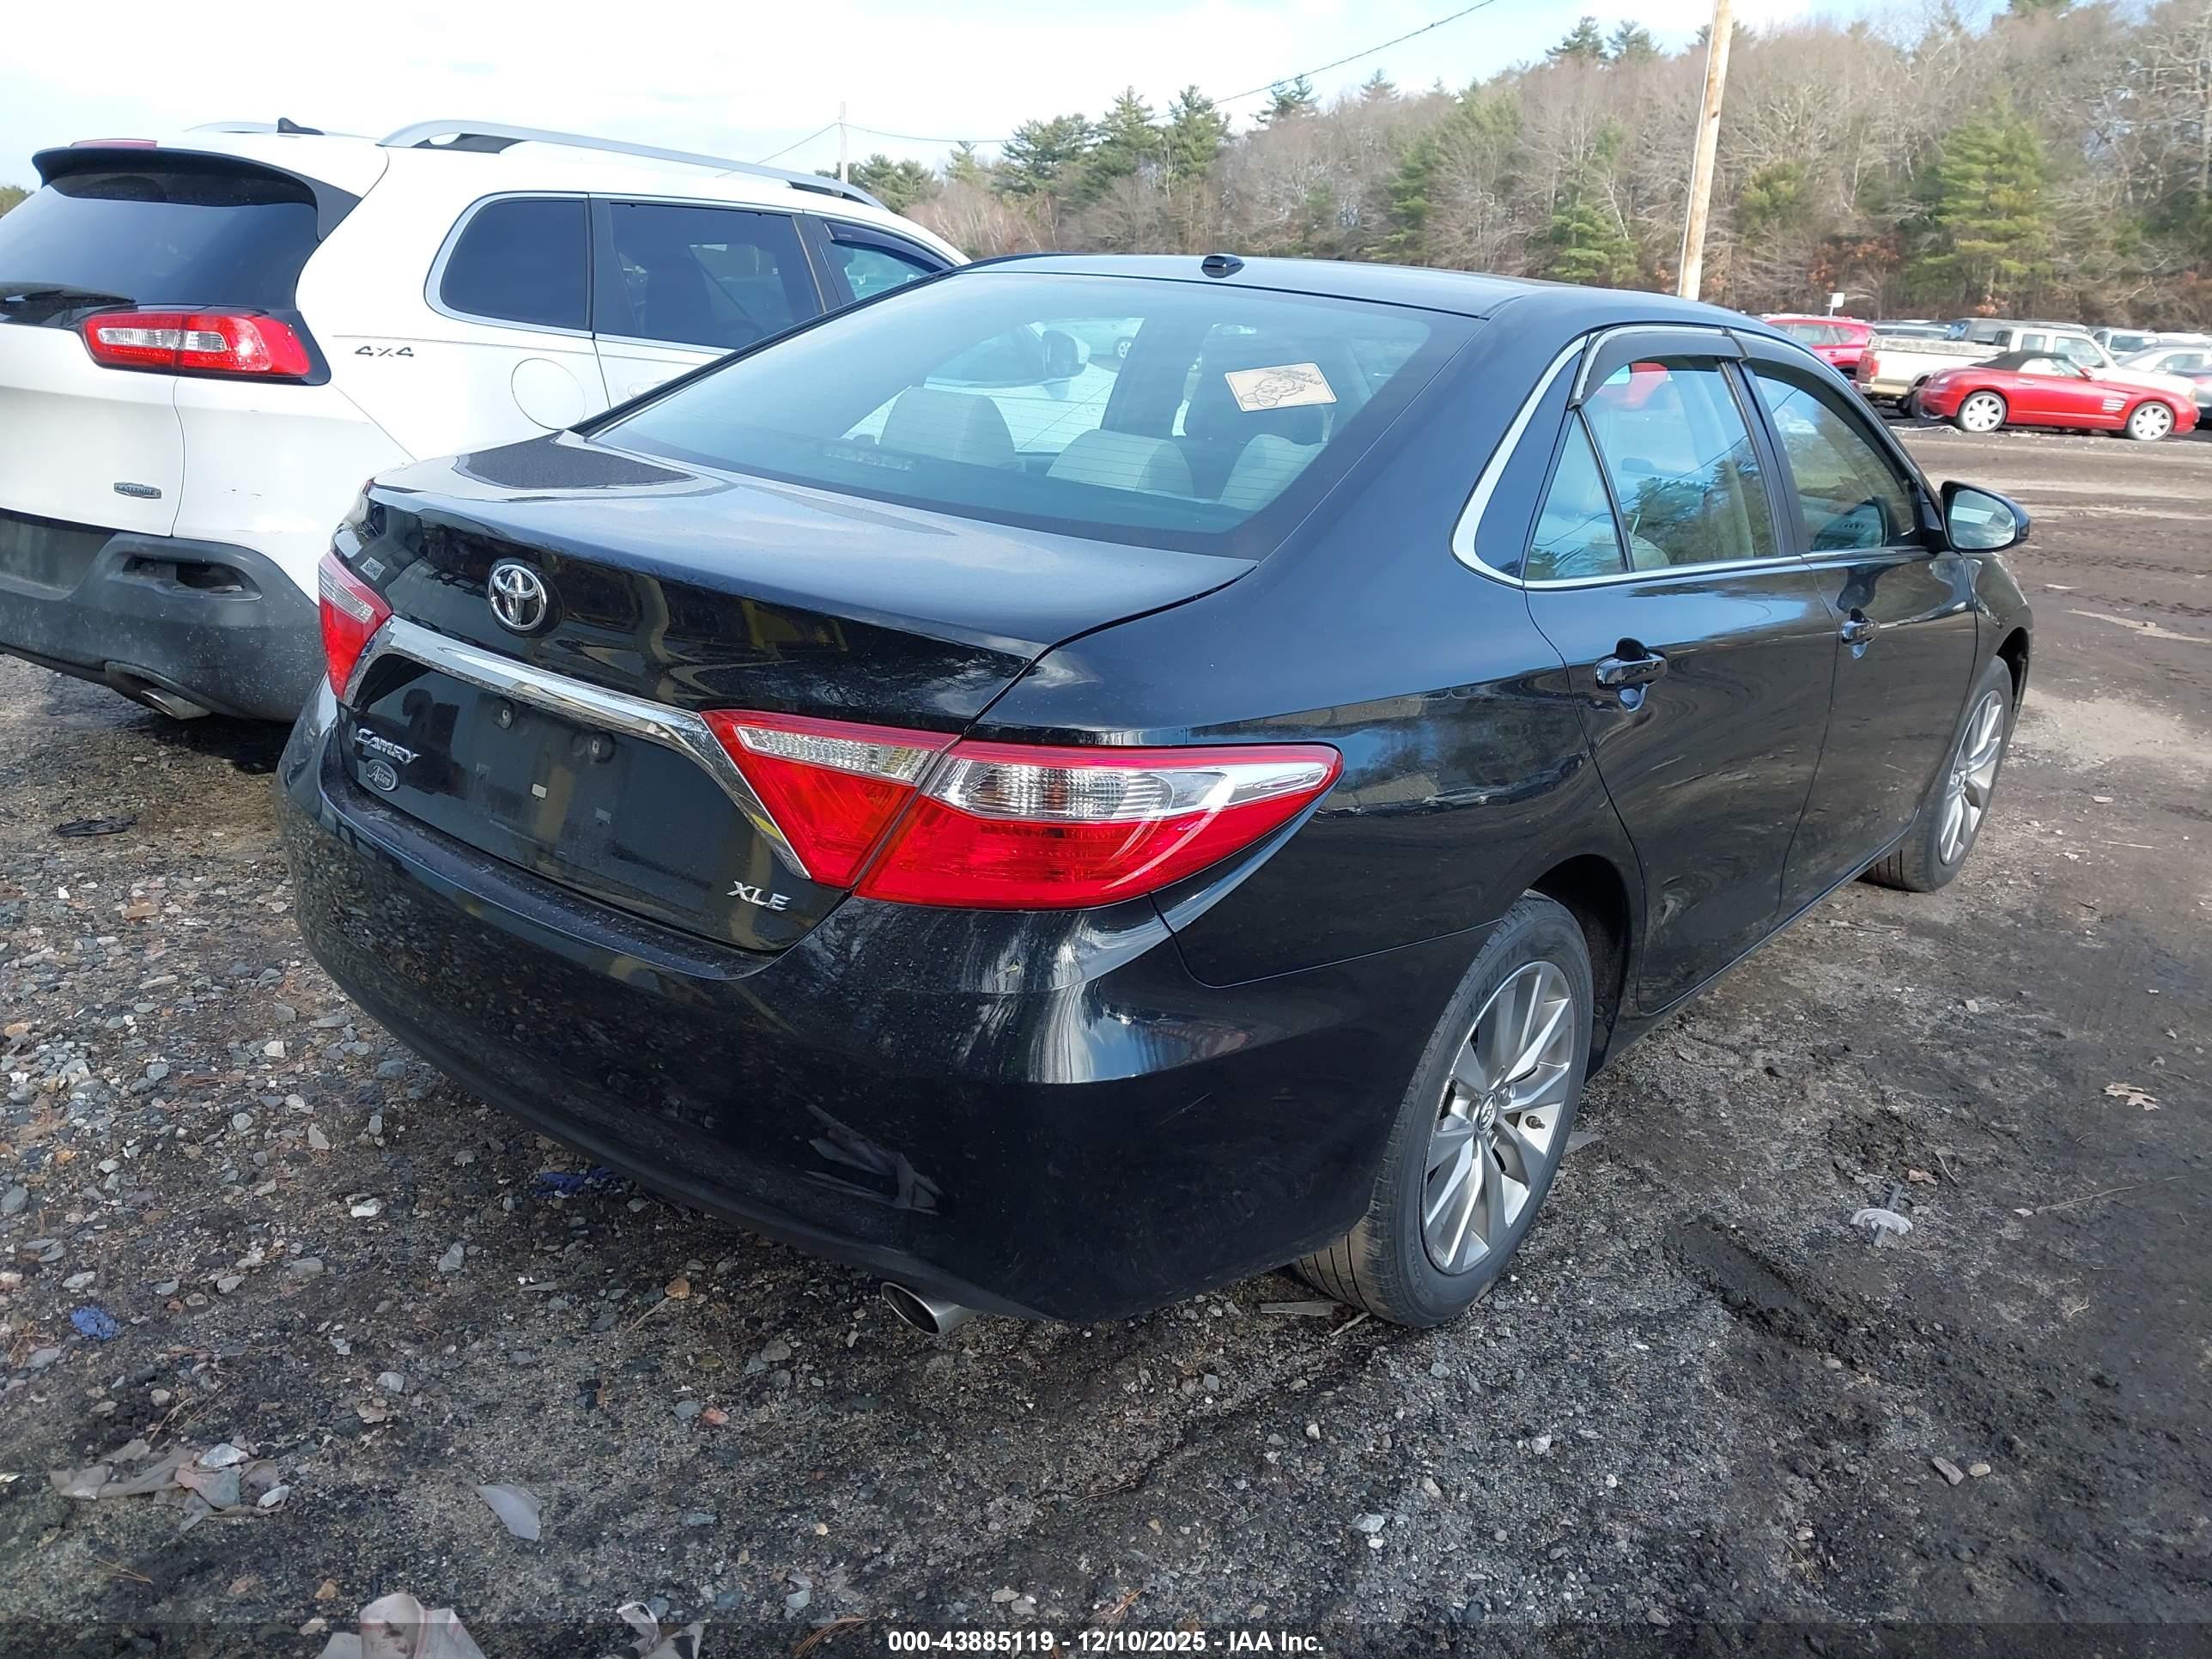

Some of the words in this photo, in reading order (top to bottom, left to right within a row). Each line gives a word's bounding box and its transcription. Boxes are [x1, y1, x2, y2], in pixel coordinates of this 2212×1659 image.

[355, 728, 421, 766] CAMRY
[367, 765, 391, 786] Acton
[726, 880, 792, 911] XLE
